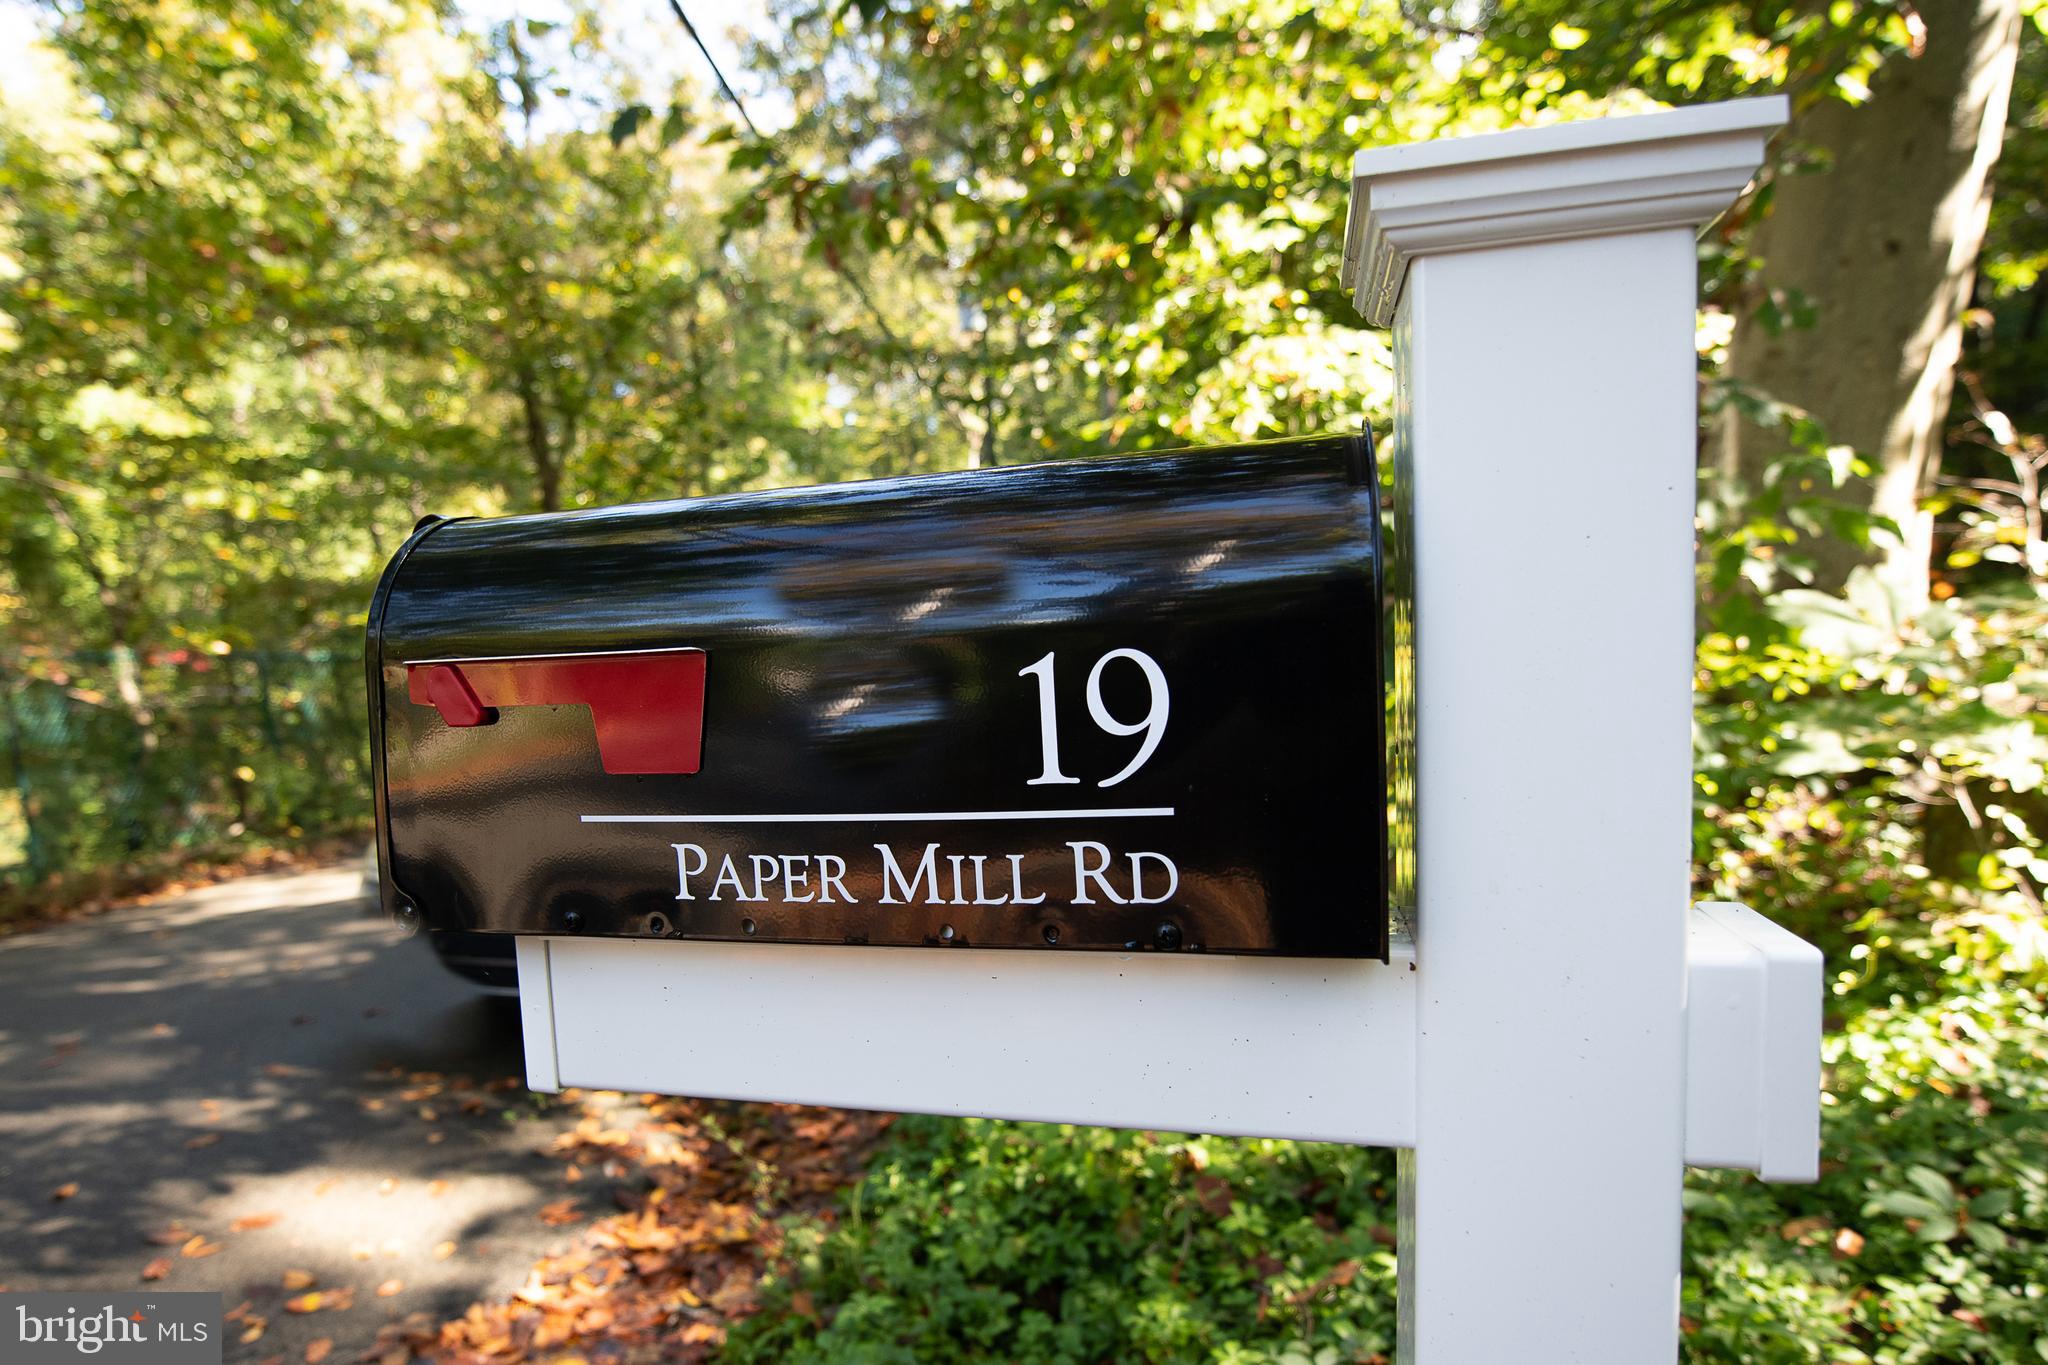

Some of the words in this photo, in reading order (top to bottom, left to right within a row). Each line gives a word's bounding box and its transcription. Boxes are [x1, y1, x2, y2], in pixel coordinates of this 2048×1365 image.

[1019, 648, 1170, 788] 19
[671, 843, 859, 905] PAPER
[874, 842, 1047, 905] MILL
